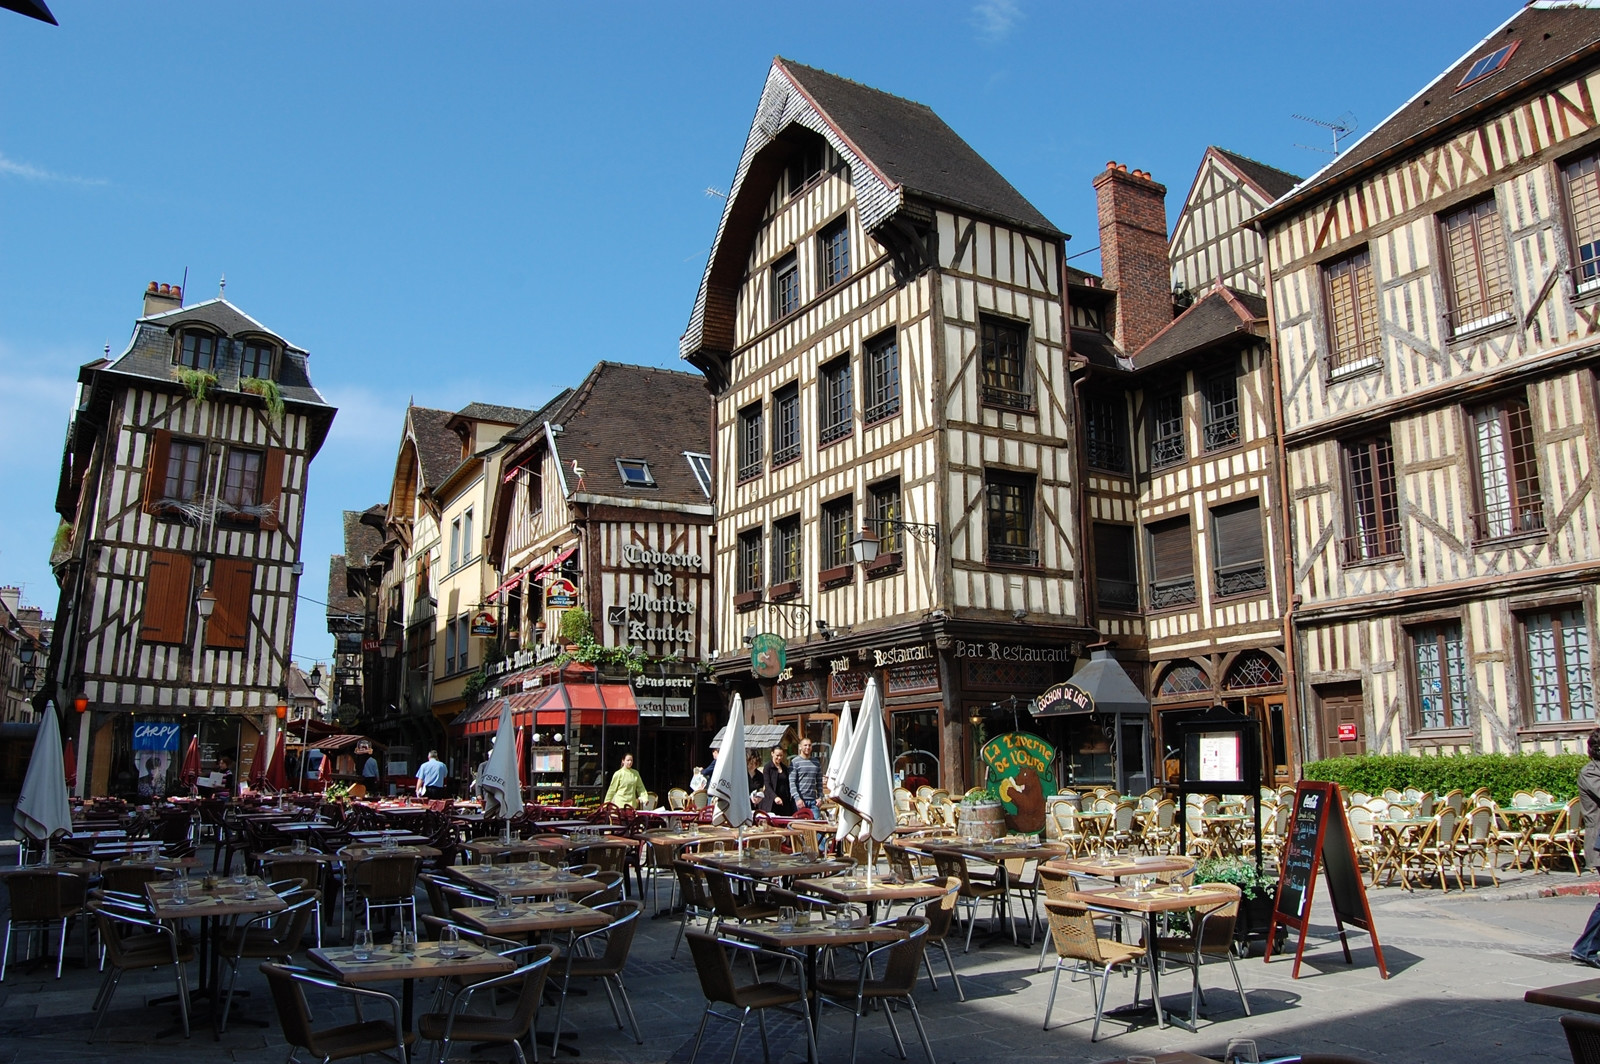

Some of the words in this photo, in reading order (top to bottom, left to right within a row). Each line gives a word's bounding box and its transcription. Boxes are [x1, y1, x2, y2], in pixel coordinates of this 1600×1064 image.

[623, 544, 702, 568] Taverne
[654, 567, 673, 587] de
[629, 621, 694, 643] Kanter
[873, 642, 933, 667] Restaurant
[954, 640, 984, 658] Bar
[987, 642, 1070, 662] Restaurant
[635, 674, 693, 688] Brasserie
[1038, 688, 1061, 711] COCHON
[1064, 688, 1073, 700] DE
[1073, 691, 1088, 709] LAIT
[984, 744, 1000, 763] La
[1003, 733, 1052, 760] Taverne
[905, 763, 926, 775] PUB
[995, 757, 1009, 772] de
[1010, 750, 1044, 772] l'Ours
